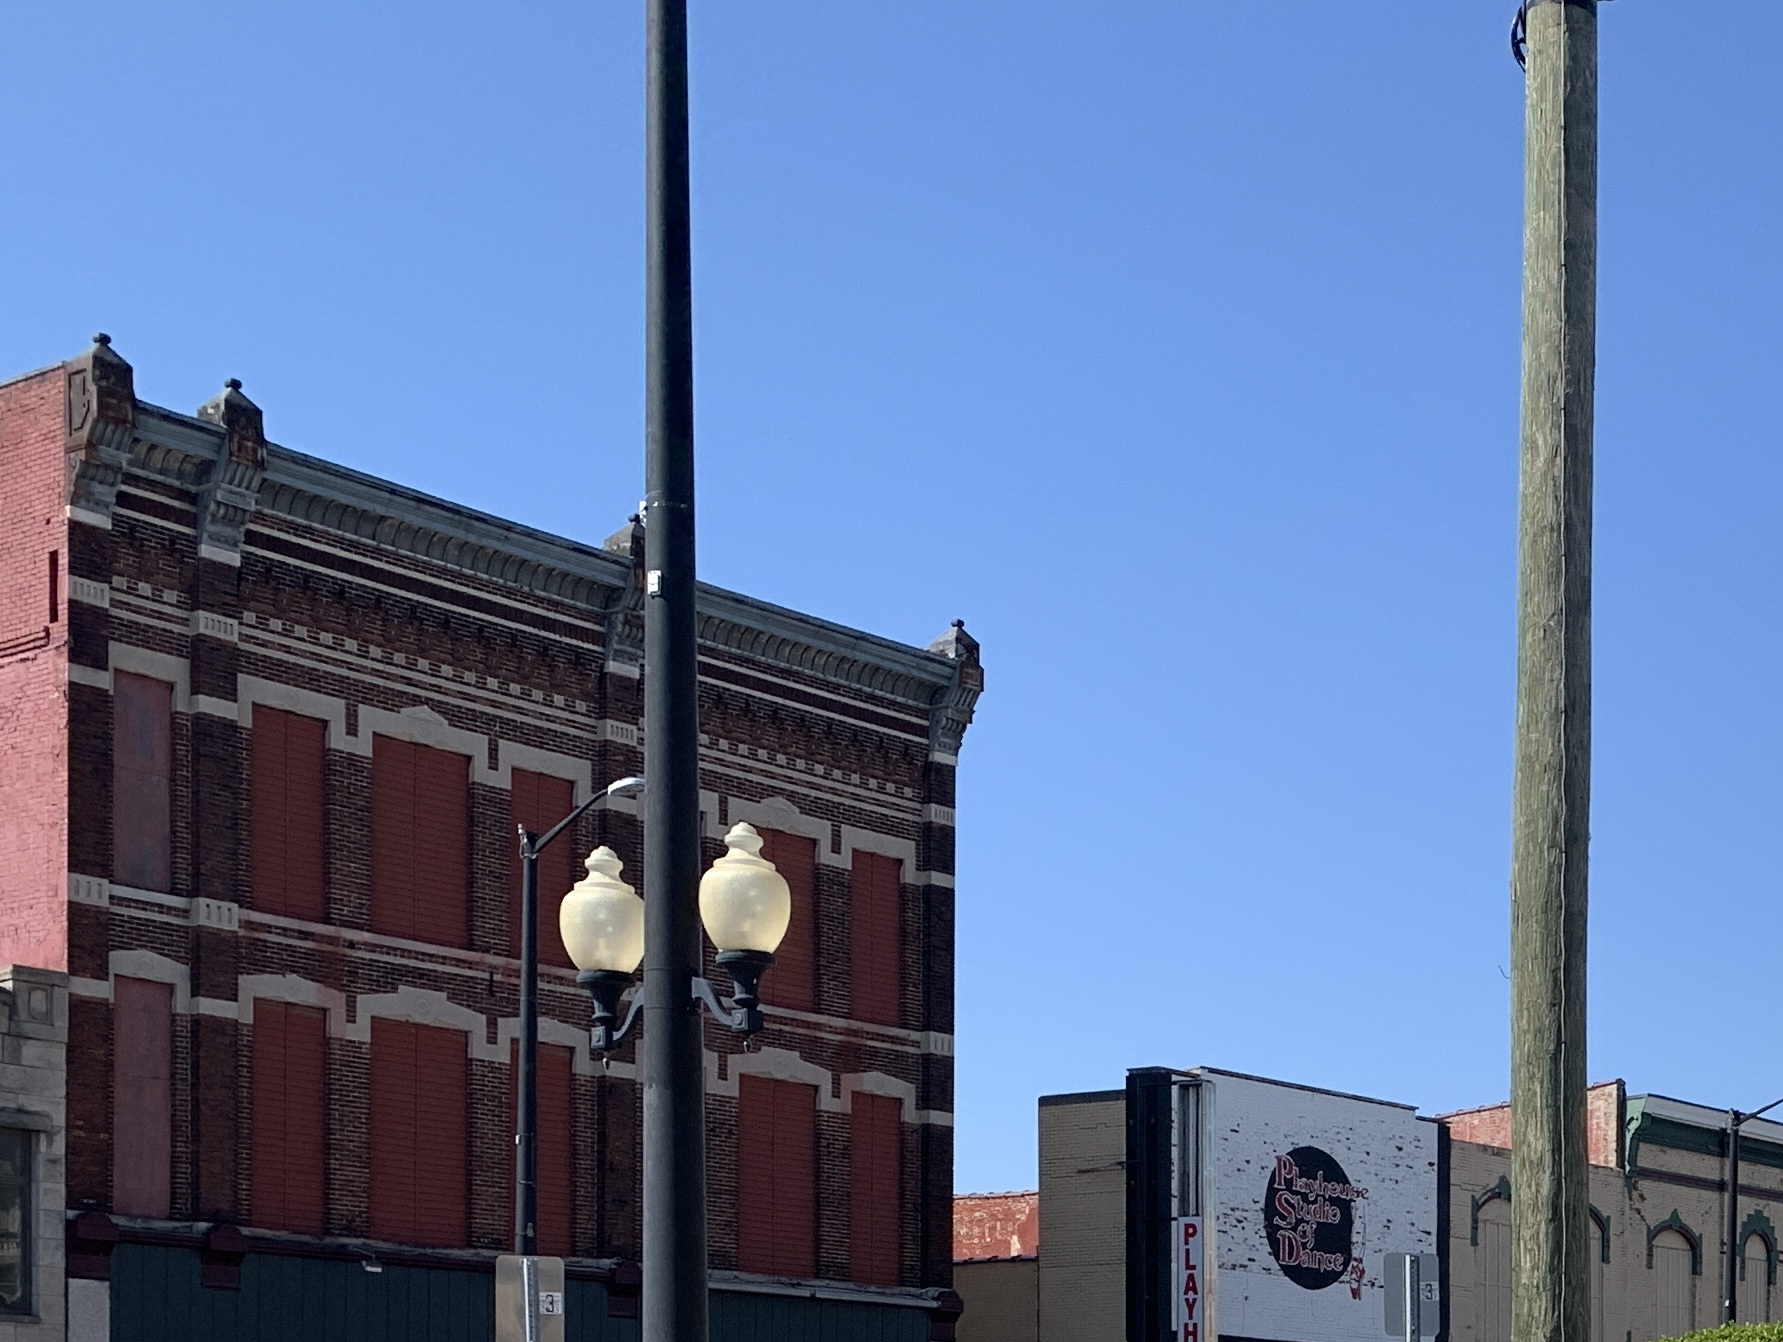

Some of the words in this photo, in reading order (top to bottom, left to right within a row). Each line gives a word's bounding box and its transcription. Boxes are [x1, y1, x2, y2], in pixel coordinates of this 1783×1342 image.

[1274, 1154, 1369, 1200] Playhouse
[1273, 1191, 1341, 1228] Studio
[1277, 1229, 1344, 1272] Dance
[1297, 1220, 1317, 1249] of
[546, 1294, 554, 1313] 3
